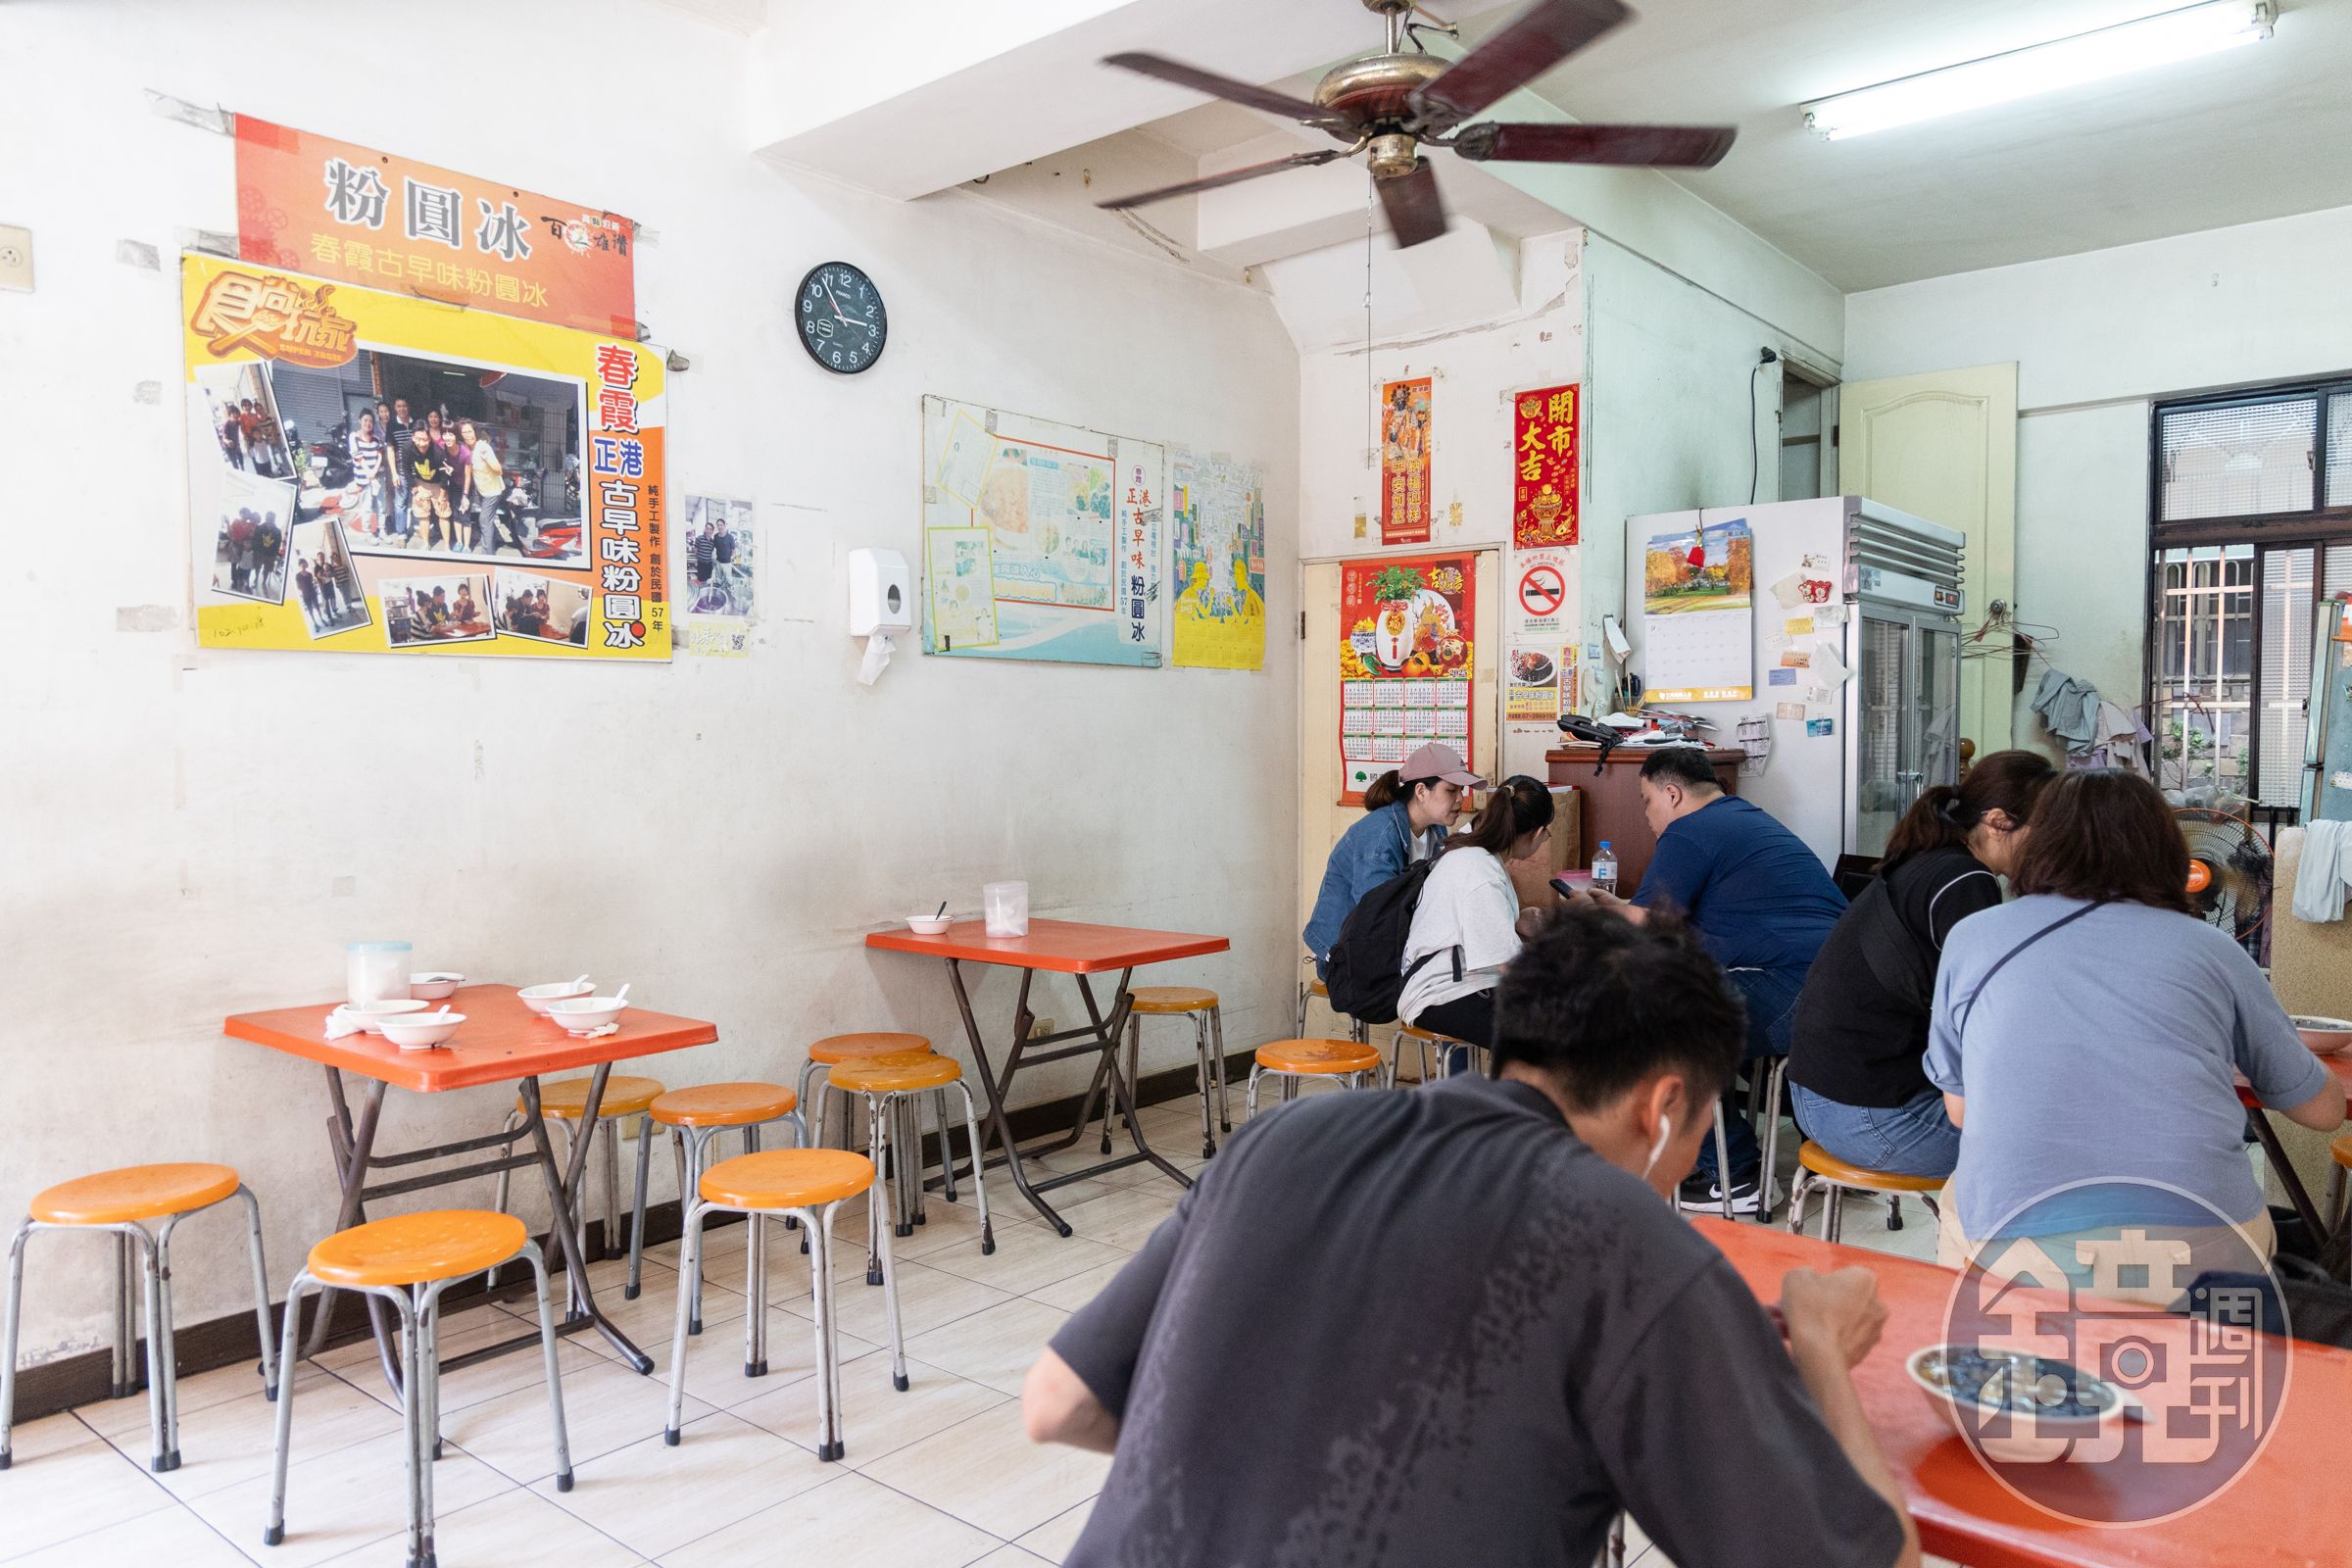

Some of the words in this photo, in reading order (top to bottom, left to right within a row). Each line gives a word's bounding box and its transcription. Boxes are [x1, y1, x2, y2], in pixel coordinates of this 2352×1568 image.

[325, 158, 532, 261] 粉圓冰
[310, 233, 549, 308] 春霞古早味粉圓冰
[824, 273, 833, 286] 11
[840, 273, 851, 287] 12
[811, 283, 822, 298] 10
[193, 271, 357, 352] 食尚玩家
[804, 300, 812, 313] 9
[865, 306, 874, 318] 2
[806, 320, 815, 334] 8
[868, 324, 876, 337] 3
[279, 344, 312, 356] SUPER
[816, 338, 825, 351] 7
[862, 342, 869, 353] 4
[832, 351, 841, 364] 6
[850, 351, 858, 364] 5
[597, 345, 638, 433] 春霞
[1546, 390, 1574, 457] 開市
[594, 437, 644, 478] 正港
[1518, 420, 1545, 481] 大吉
[1126, 487, 1152, 507] 正港
[648, 484, 661, 547] 純手工製作
[599, 479, 645, 648] 古早味粉圓冰
[1130, 508, 1146, 642] 古早味粉圓冰
[650, 553, 663, 632] 創於民國57年
[1449, 668, 1468, 677] 2025
